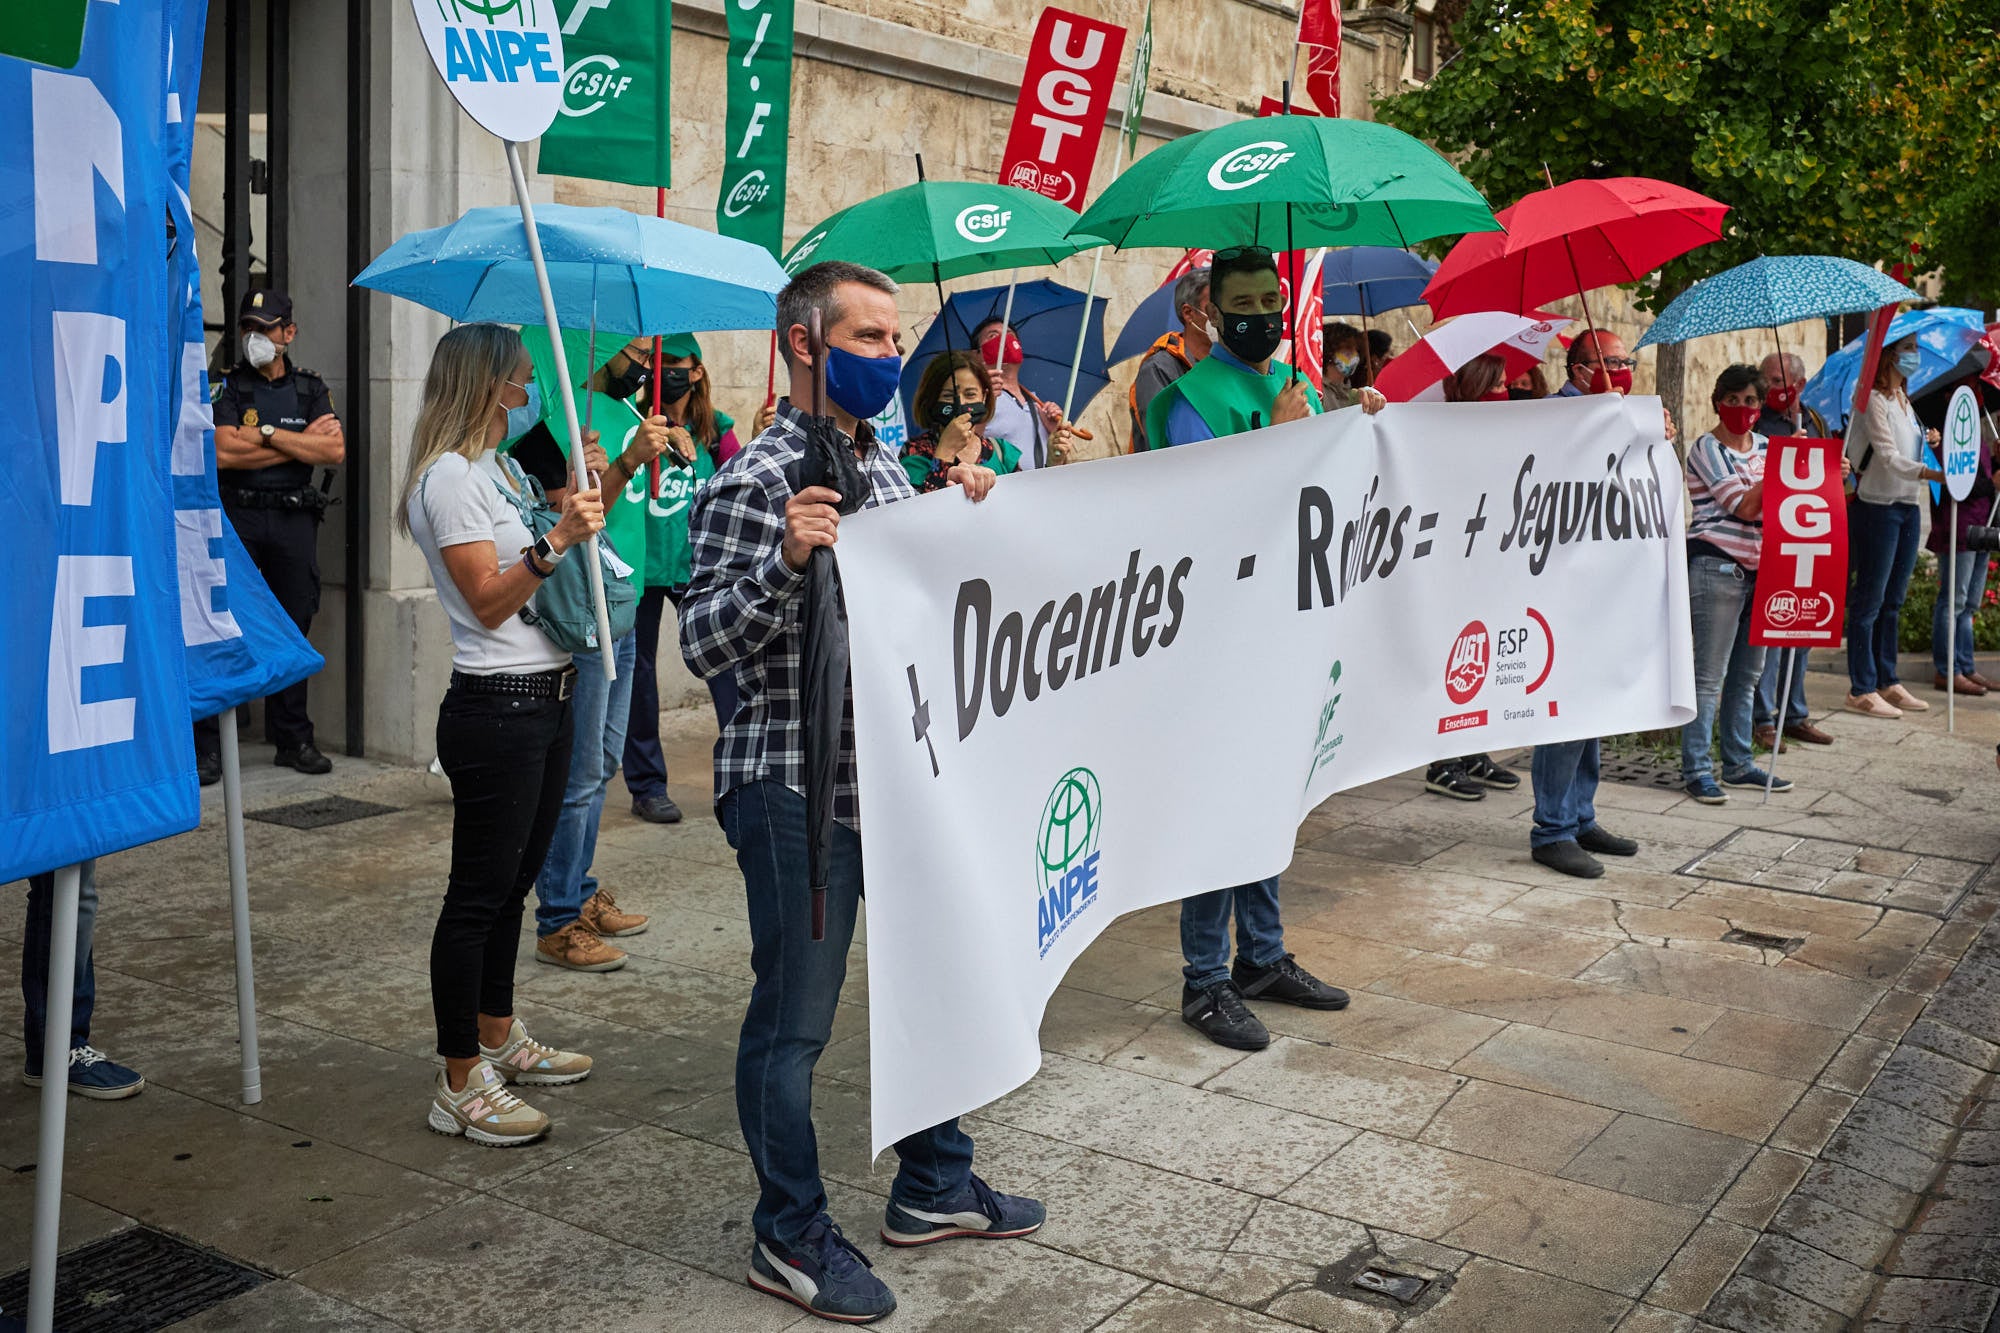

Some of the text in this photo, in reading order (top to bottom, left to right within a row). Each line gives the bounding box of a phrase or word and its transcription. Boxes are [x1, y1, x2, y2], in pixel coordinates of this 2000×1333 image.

[444, 27, 560, 83] ANPE
[1030, 19, 1107, 164] UGT
[1226, 152, 1296, 173] CSIF
[1013, 166, 1037, 184] UGT
[967, 210, 1012, 230] CSIF
[875, 424, 904, 447] NPE
[1947, 451, 1976, 476] ANPE
[1778, 447, 1831, 588] UGT
[953, 549, 1193, 742] Docentes
[1500, 445, 1669, 576] Seguridad
[1770, 597, 1796, 612] UGT
[1450, 632, 1486, 670] UGT
[1496, 660, 1527, 672] Servicios
[1495, 673, 1525, 686] Públicos
[1445, 715, 1479, 731] Enseñanza
[1503, 708, 1535, 720] Granada
[1038, 850, 1100, 950] ANPE
